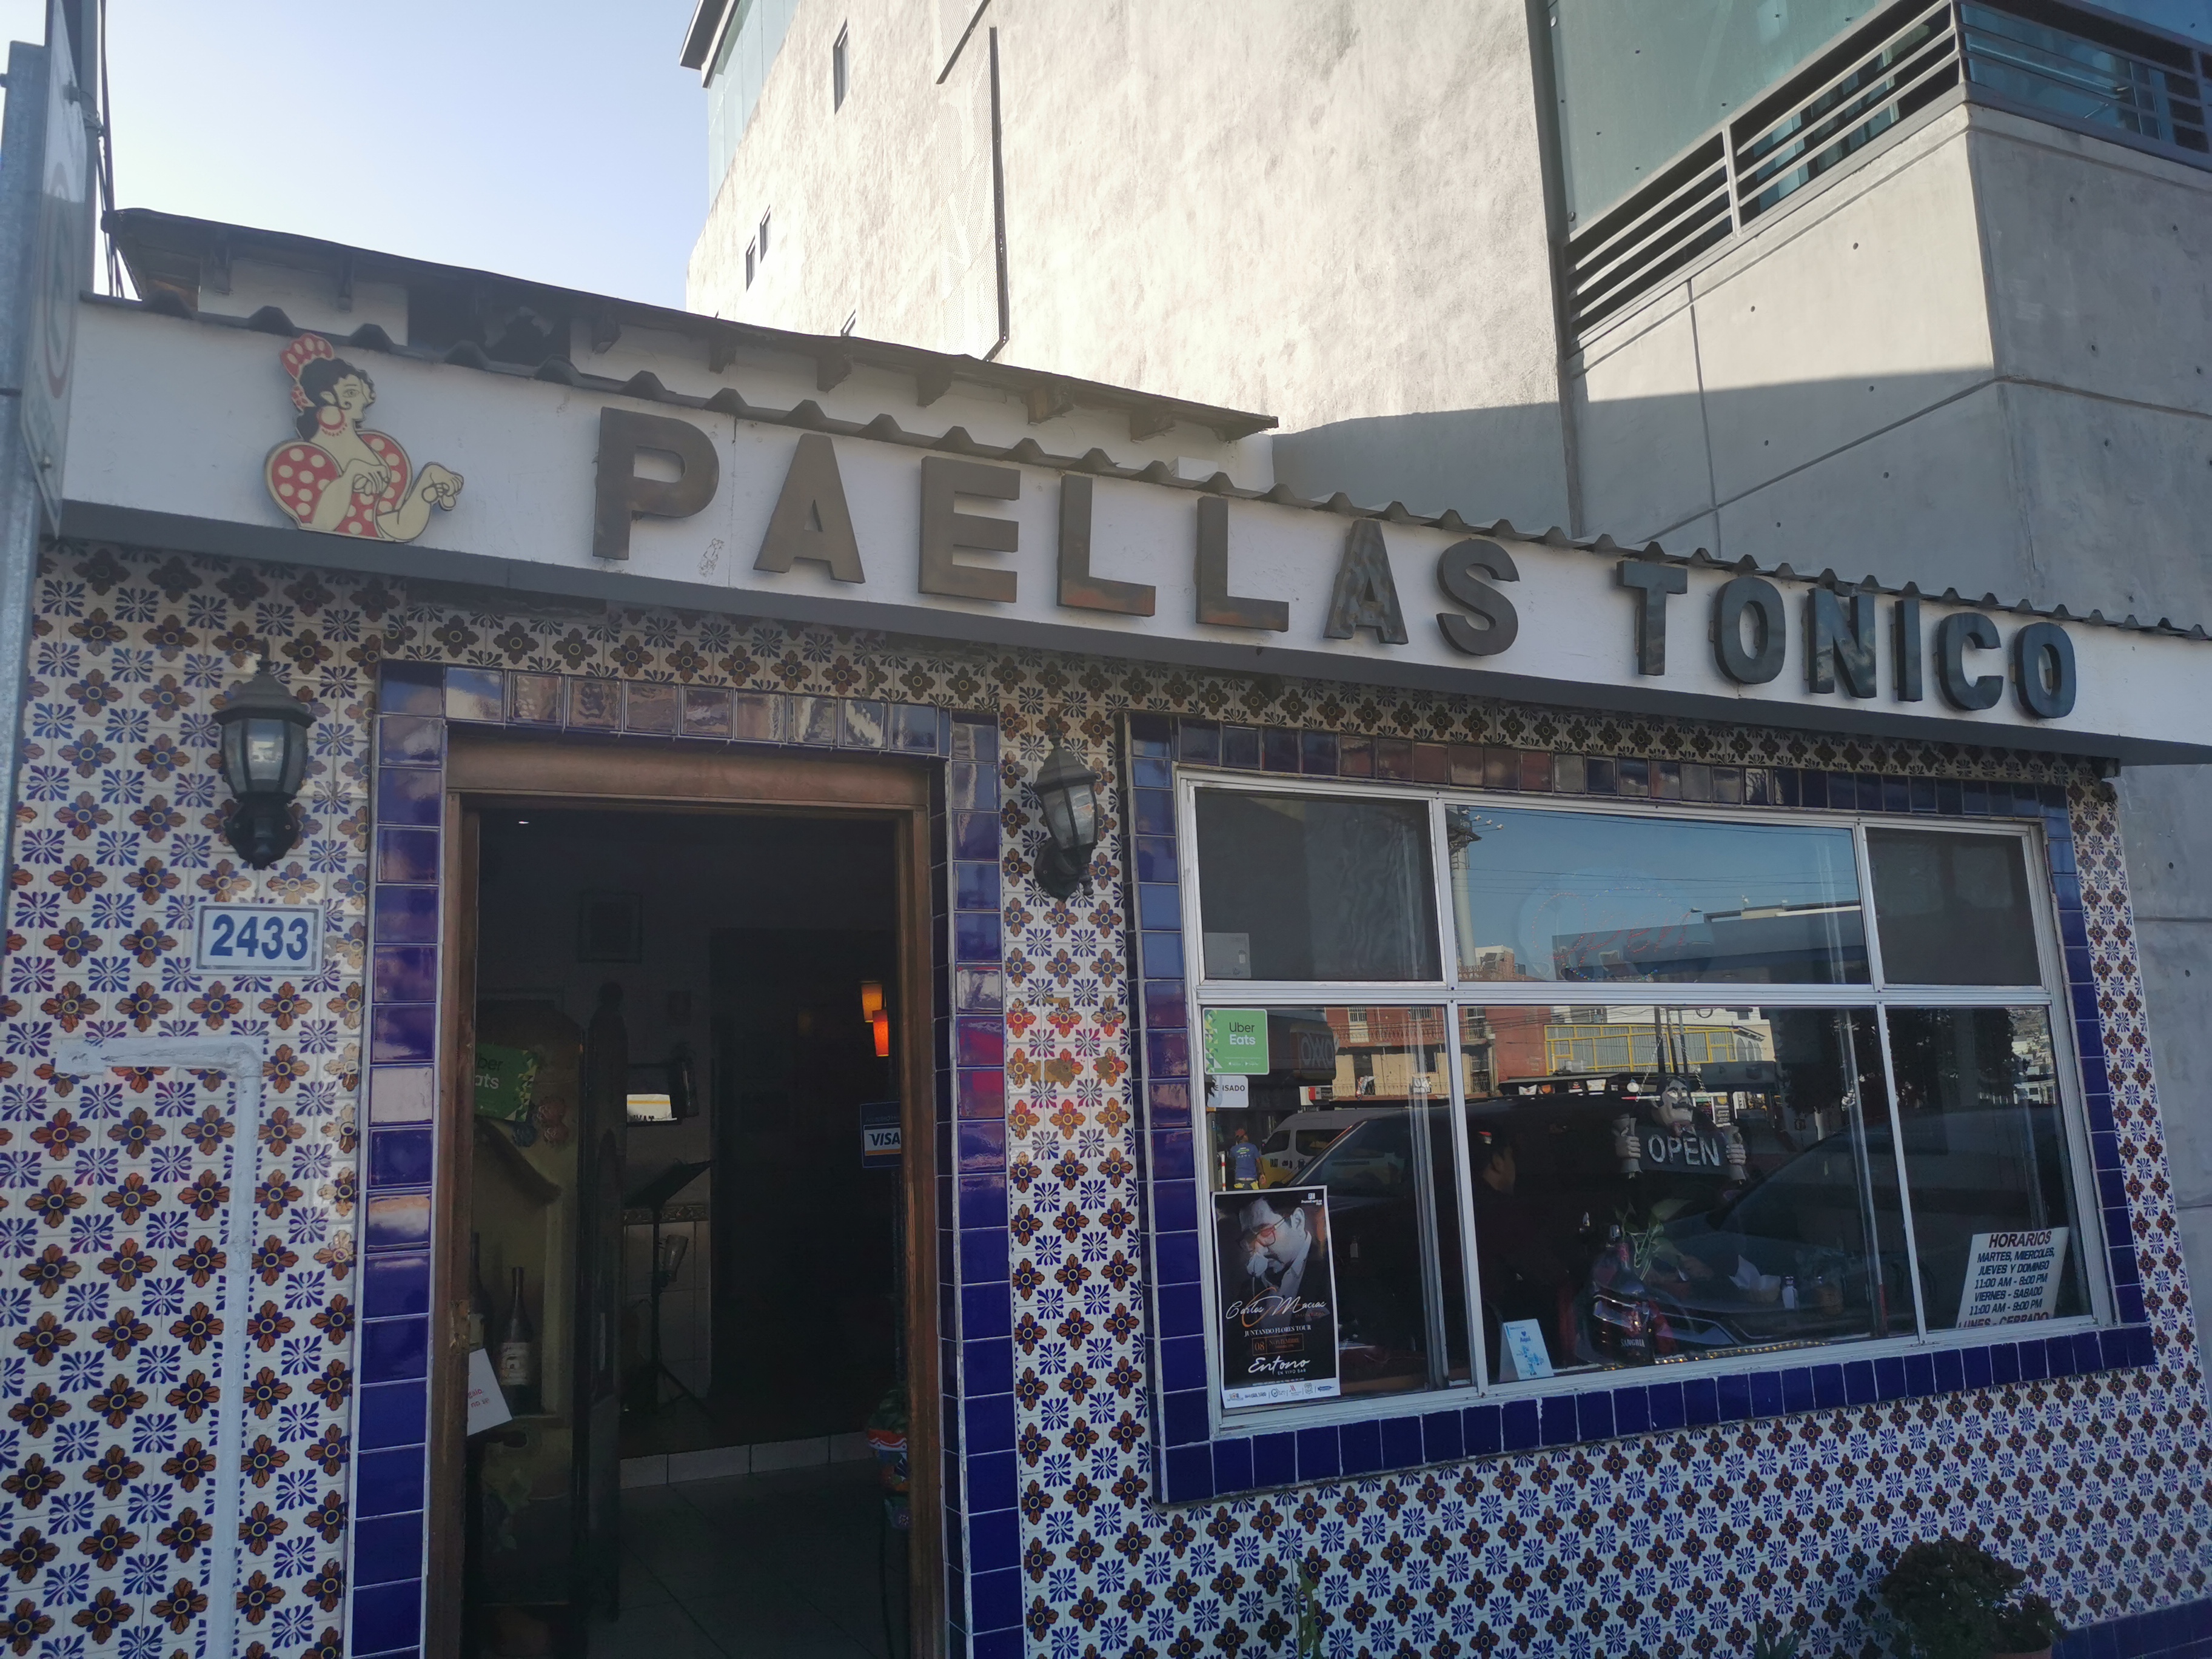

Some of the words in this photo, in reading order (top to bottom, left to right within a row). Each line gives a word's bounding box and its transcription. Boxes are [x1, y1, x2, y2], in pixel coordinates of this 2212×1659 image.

[592, 406, 1521, 657] PAELLAS
[1615, 559, 2077, 719] TONICO
[210, 914, 309, 960] 2433
[1229, 1022, 1255, 1033] Uber
[1229, 1034, 1256, 1045] Eats
[476, 1054, 504, 1071] ber
[475, 1073, 500, 1090] ats
[868, 1131, 901, 1146] VISA
[1647, 1133, 1721, 1167] OPEN
[1988, 1230, 2052, 1248] HORARIOS
[1977, 1252, 2013, 1263] MARTES,
[2014, 1247, 2055, 1261] MIERCOLES,
[1977, 1264, 2008, 1276] JUEVES
[2009, 1264, 2017, 1273] Y
[2017, 1260, 2050, 1273] DOMINGO
[1974, 1278, 1996, 1289] 11:00
[1997, 1277, 2013, 1287] AM
[2036, 1273, 2049, 1284] PM
[1974, 1290, 2007, 1302] VIERNES
[2013, 1285, 2043, 1299] SABADO
[1969, 1304, 1991, 1316] 11:00
[1991, 1304, 2006, 1314] AM
[2029, 1298, 2043, 1309] PM
[1244, 1327, 1274, 1337] JUNTANDO
[1275, 1326, 1295, 1335] FLORES
[1254, 1341, 1265, 1351] 08
